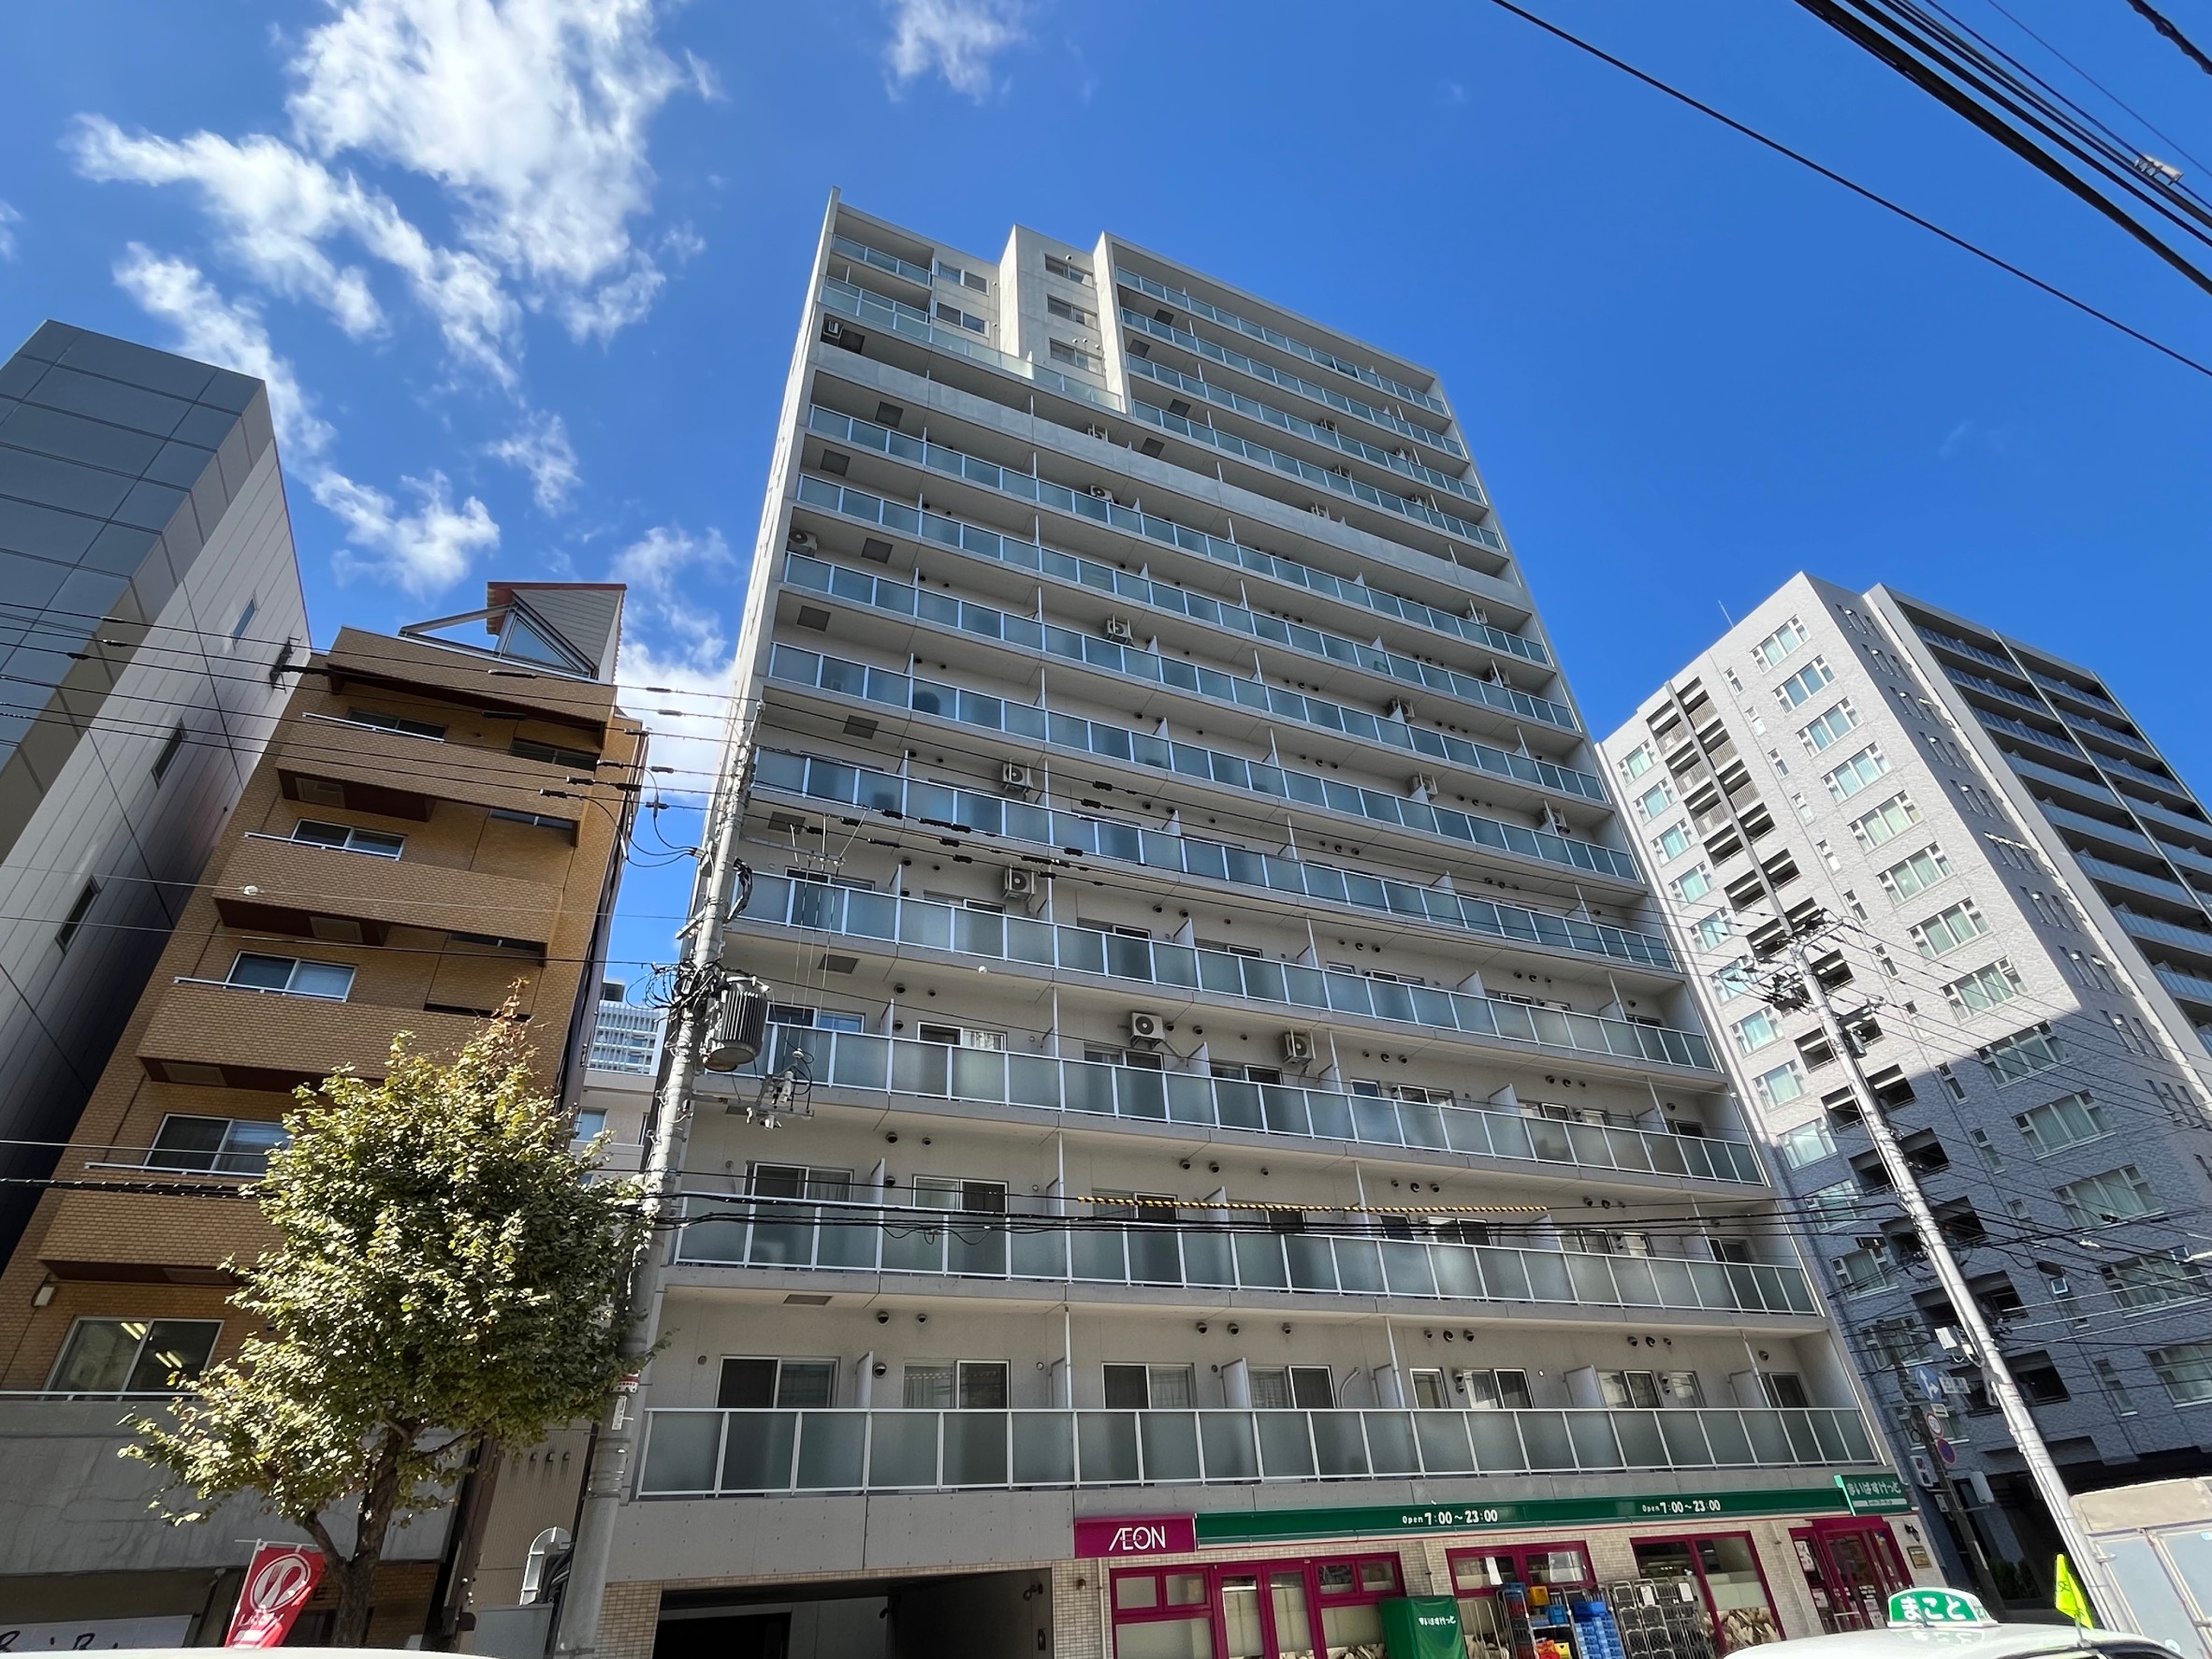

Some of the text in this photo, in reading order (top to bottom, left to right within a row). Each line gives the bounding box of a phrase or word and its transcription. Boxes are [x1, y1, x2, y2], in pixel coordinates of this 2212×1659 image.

[1641, 1505, 1660, 1513] Open
[1402, 1515, 1423, 1524] Open
[1900, 1595, 1967, 1621] まこと
